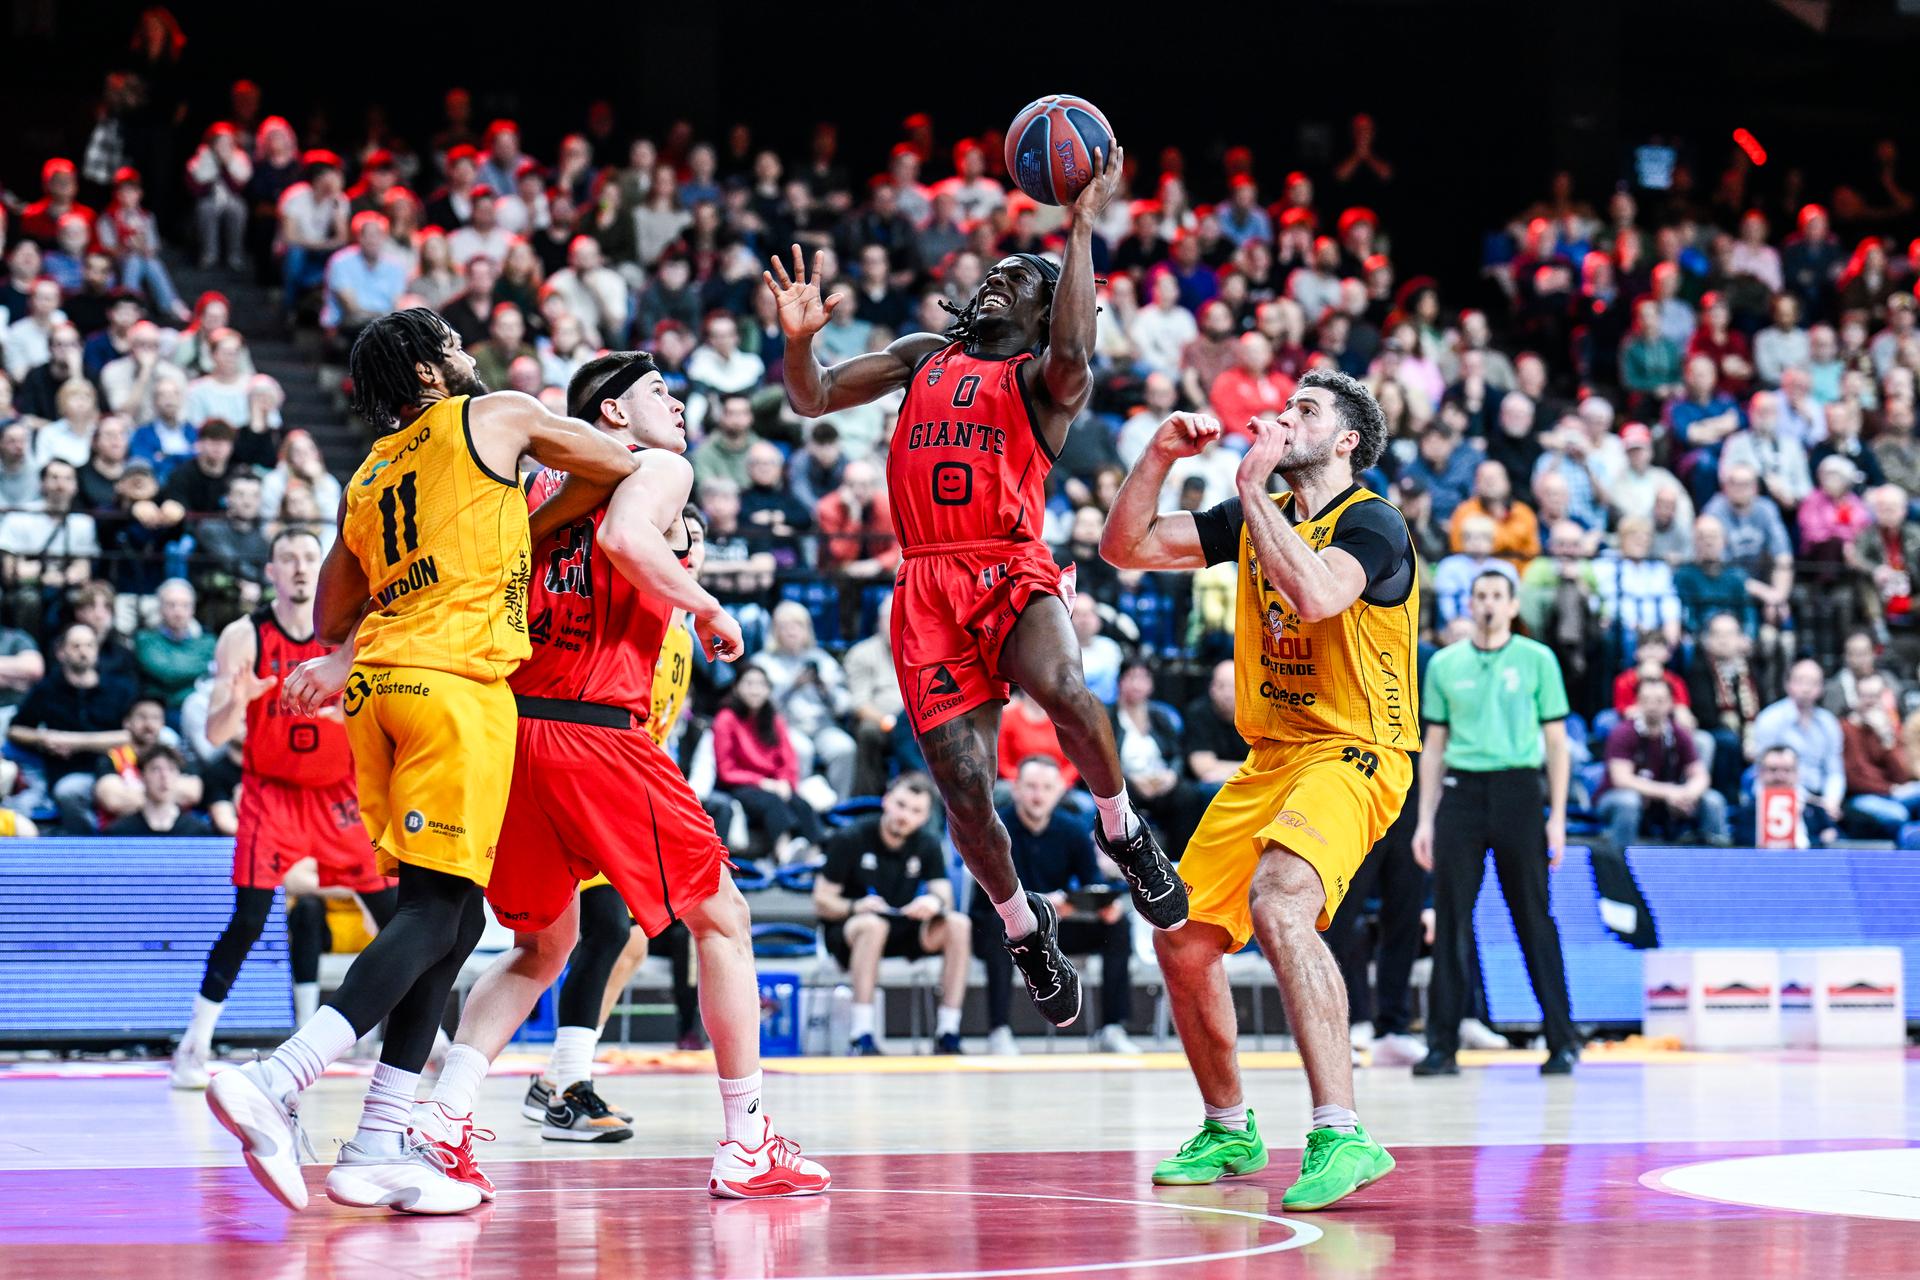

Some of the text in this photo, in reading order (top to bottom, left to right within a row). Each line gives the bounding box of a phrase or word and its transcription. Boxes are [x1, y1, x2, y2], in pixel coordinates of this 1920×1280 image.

[951, 374, 982, 408] 0
[908, 420, 1006, 456] GIANTS
[378, 470, 419, 567] 11
[672, 653, 685, 687] 31
[376, 682, 430, 697] Oostende
[921, 694, 965, 720] aertssen
[408, 815, 419, 828] B
[1766, 794, 1793, 839] 5
